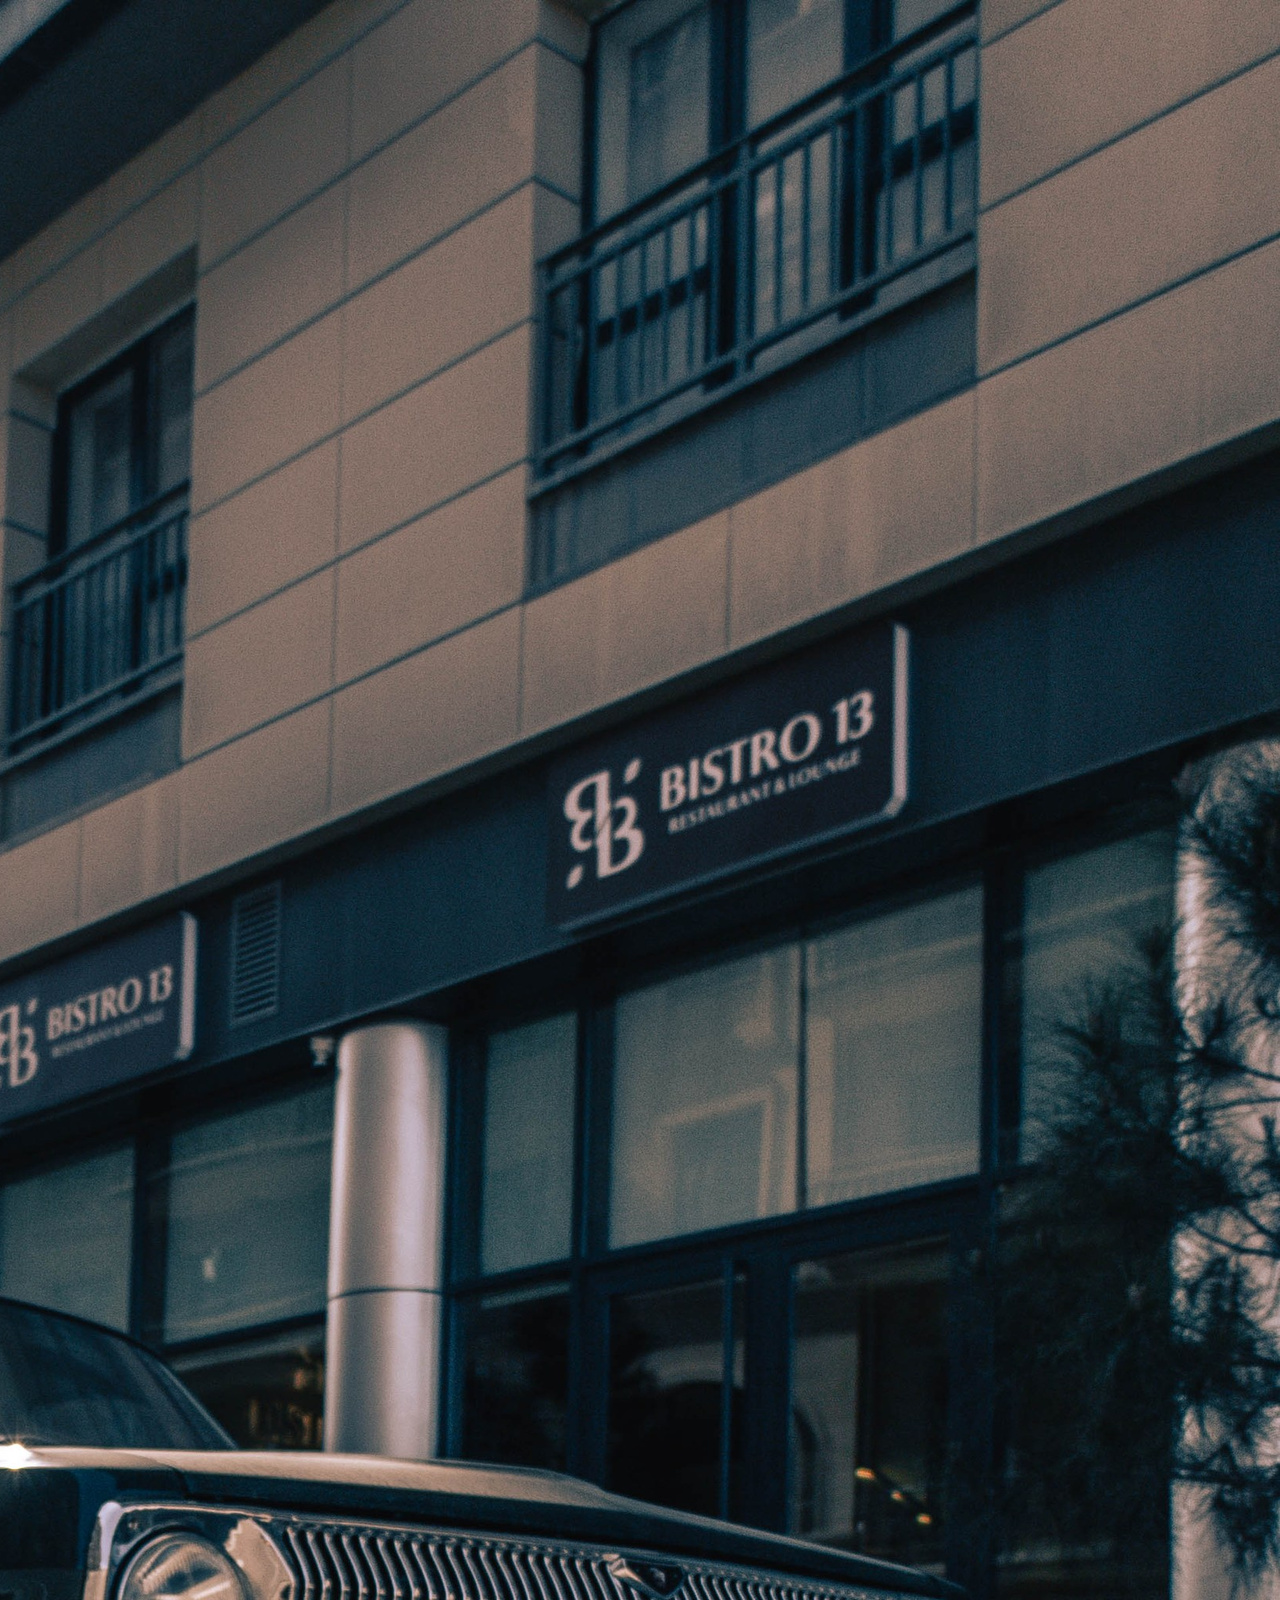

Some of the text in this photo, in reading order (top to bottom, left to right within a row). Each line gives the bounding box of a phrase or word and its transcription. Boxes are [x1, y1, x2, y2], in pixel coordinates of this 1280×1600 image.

[659, 689, 876, 812] BISTRO 13
[46, 976, 143, 1042] BISTRO
[147, 963, 174, 1002] 13
